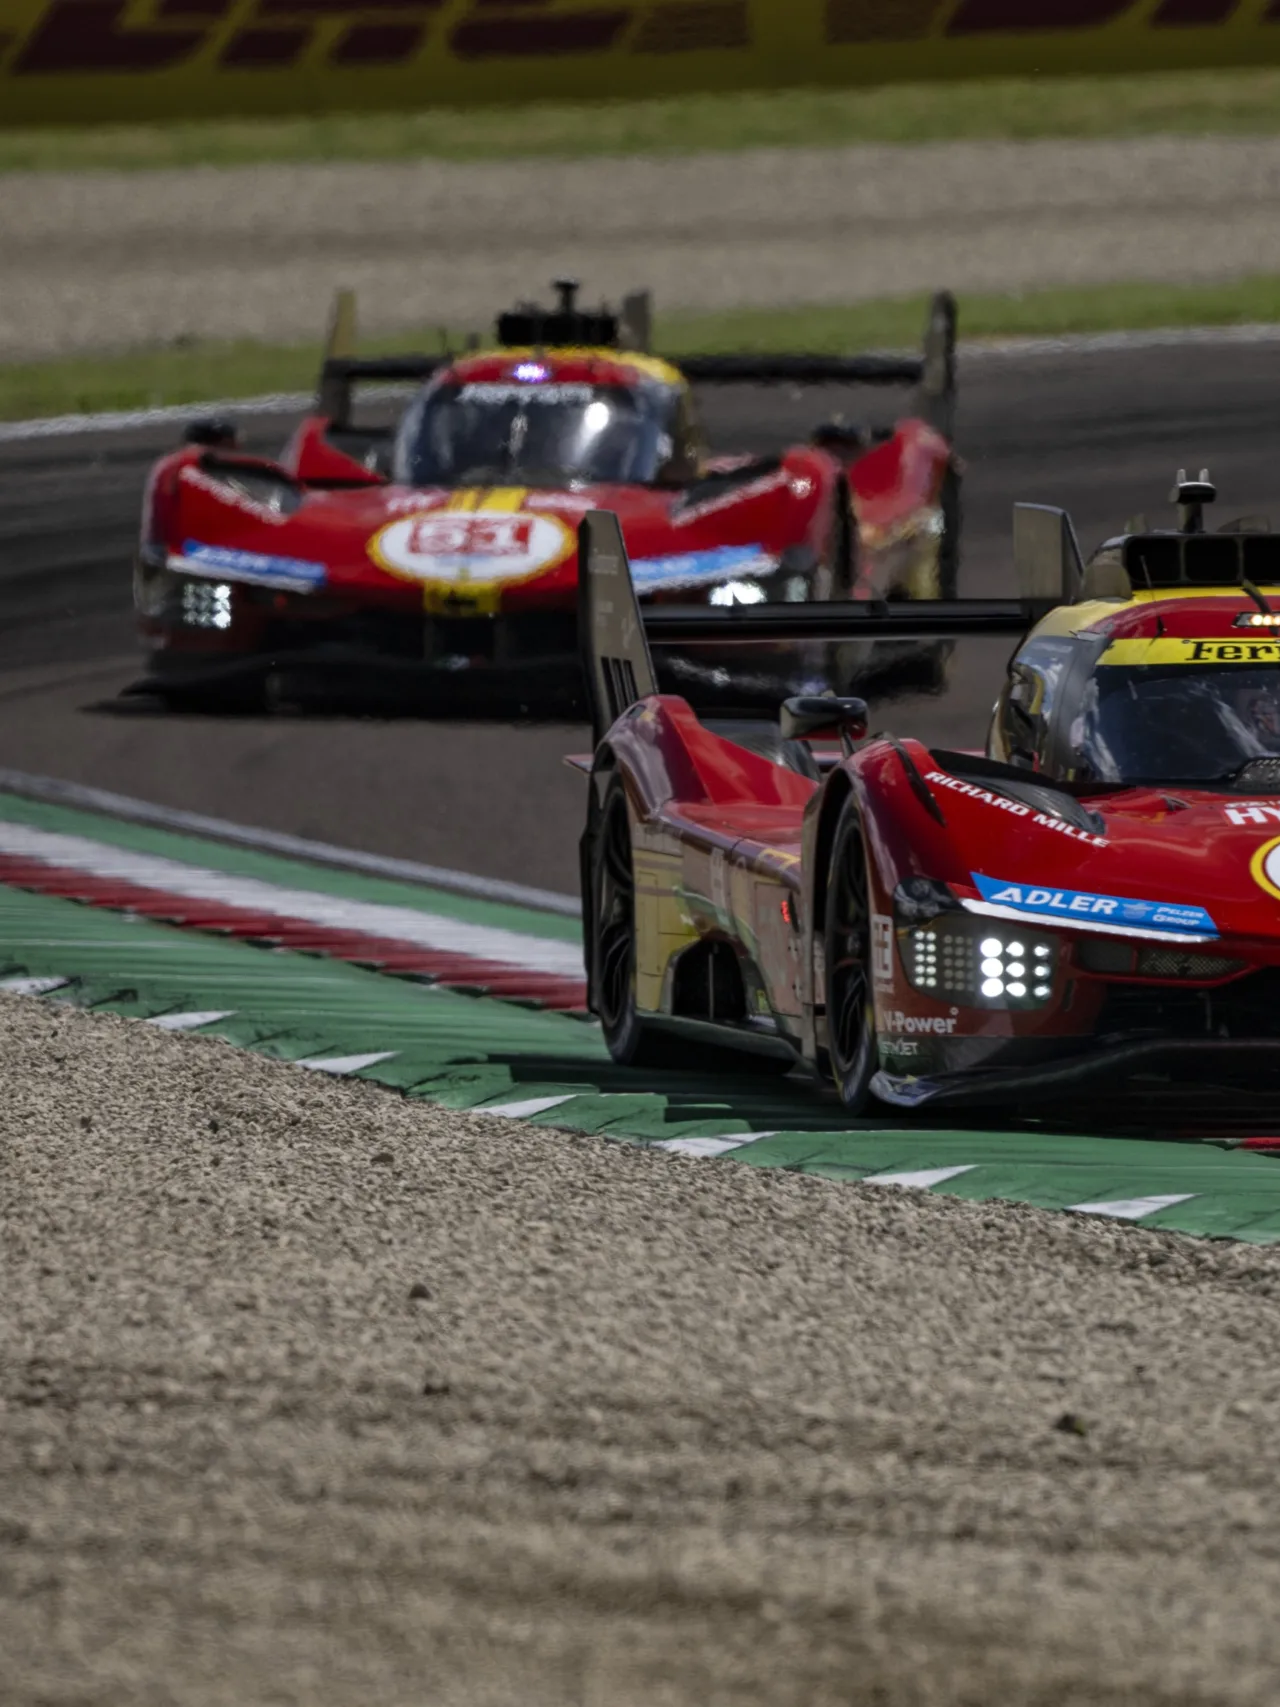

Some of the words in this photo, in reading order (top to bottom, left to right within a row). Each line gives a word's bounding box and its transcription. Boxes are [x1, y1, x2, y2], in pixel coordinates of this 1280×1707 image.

[924, 771, 1031, 817] RICHARD
[1032, 813, 1111, 848] MILLE
[990, 887, 1119, 914] ADLER
